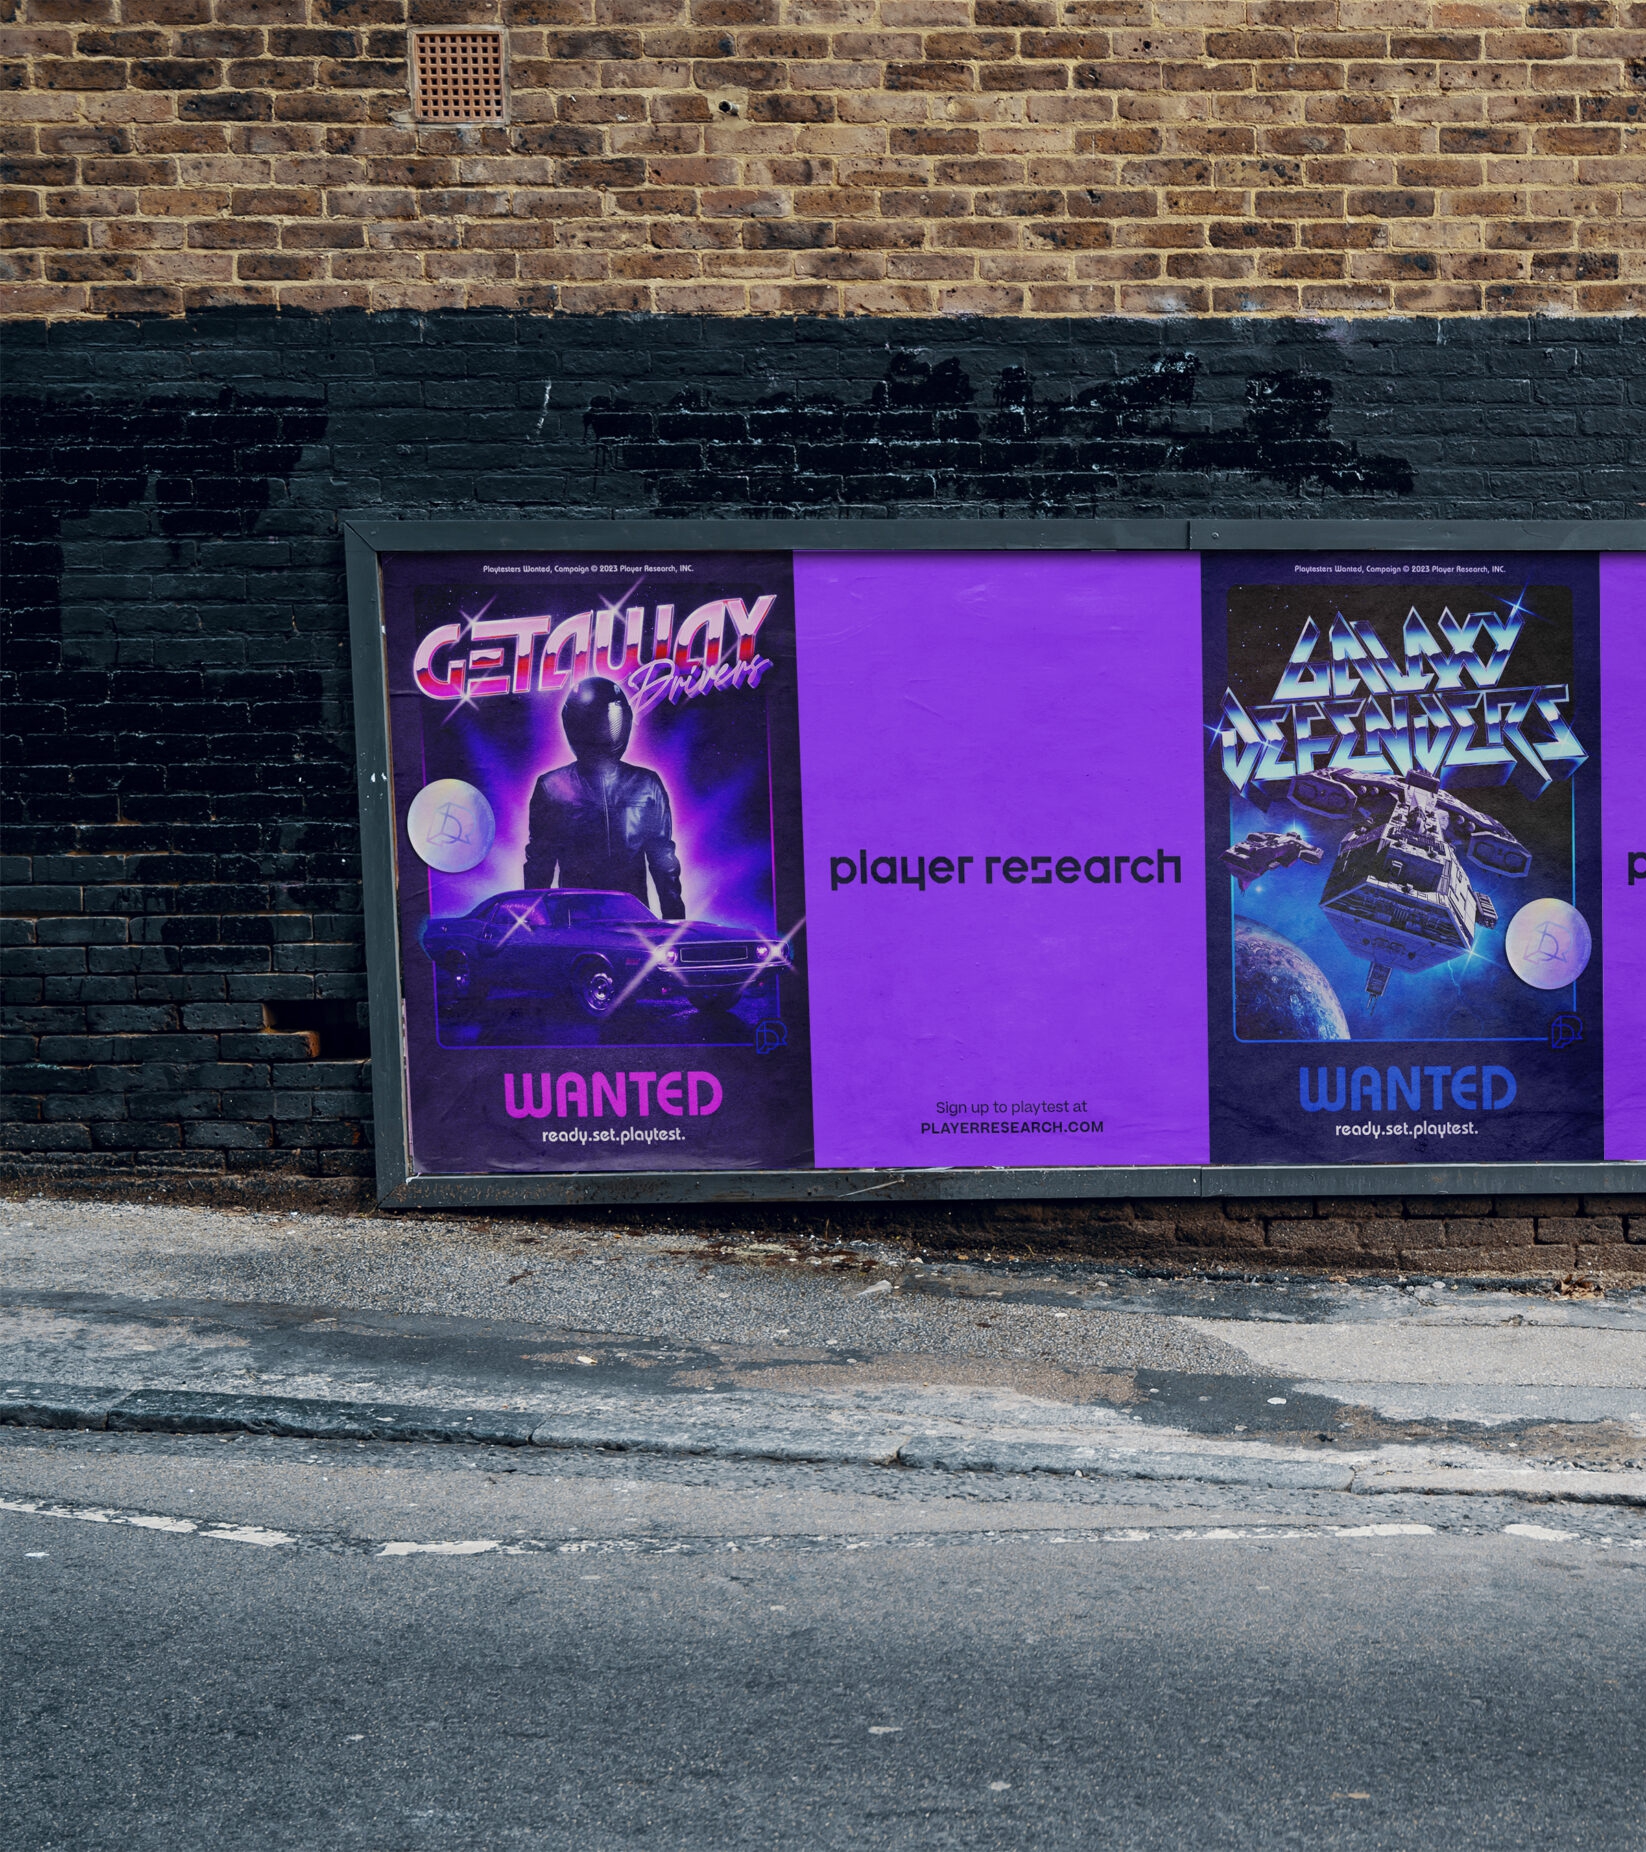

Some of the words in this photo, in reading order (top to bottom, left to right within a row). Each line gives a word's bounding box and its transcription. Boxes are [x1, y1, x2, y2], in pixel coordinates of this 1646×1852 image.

[483, 565, 521, 574] Playtesters
[523, 565, 552, 574] Wanted,
[554, 565, 589, 574] Campaign
[620, 565, 642, 574] Player
[644, 565, 677, 574] Research,
[1294, 565, 1332, 574] Playtesters
[1335, 565, 1364, 574] Wanted,
[1366, 565, 1401, 574] Campaign
[1432, 565, 1454, 574] Player
[1456, 565, 1490, 574] Research,
[413, 594, 777, 700] GETAWAY
[1271, 605, 1525, 702] GALAXY
[1220, 684, 1589, 794] DEFENDERS
[830, 849, 973, 891] player
[985, 848, 1182, 884] research
[504, 1071, 723, 1119] WANTED
[1300, 1065, 1517, 1112] WANTED
[936, 1101, 967, 1117] Sign
[971, 1104, 990, 1116] up
[993, 1101, 1008, 1113] to
[1011, 1100, 1069, 1116] playtest
[1073, 1101, 1088, 1113] at
[542, 1126, 686, 1145] ready.set.playtest.
[921, 1121, 1104, 1134] PLAYERRESEARCH.COM
[1335, 1121, 1479, 1139] ready.set.playtest.
